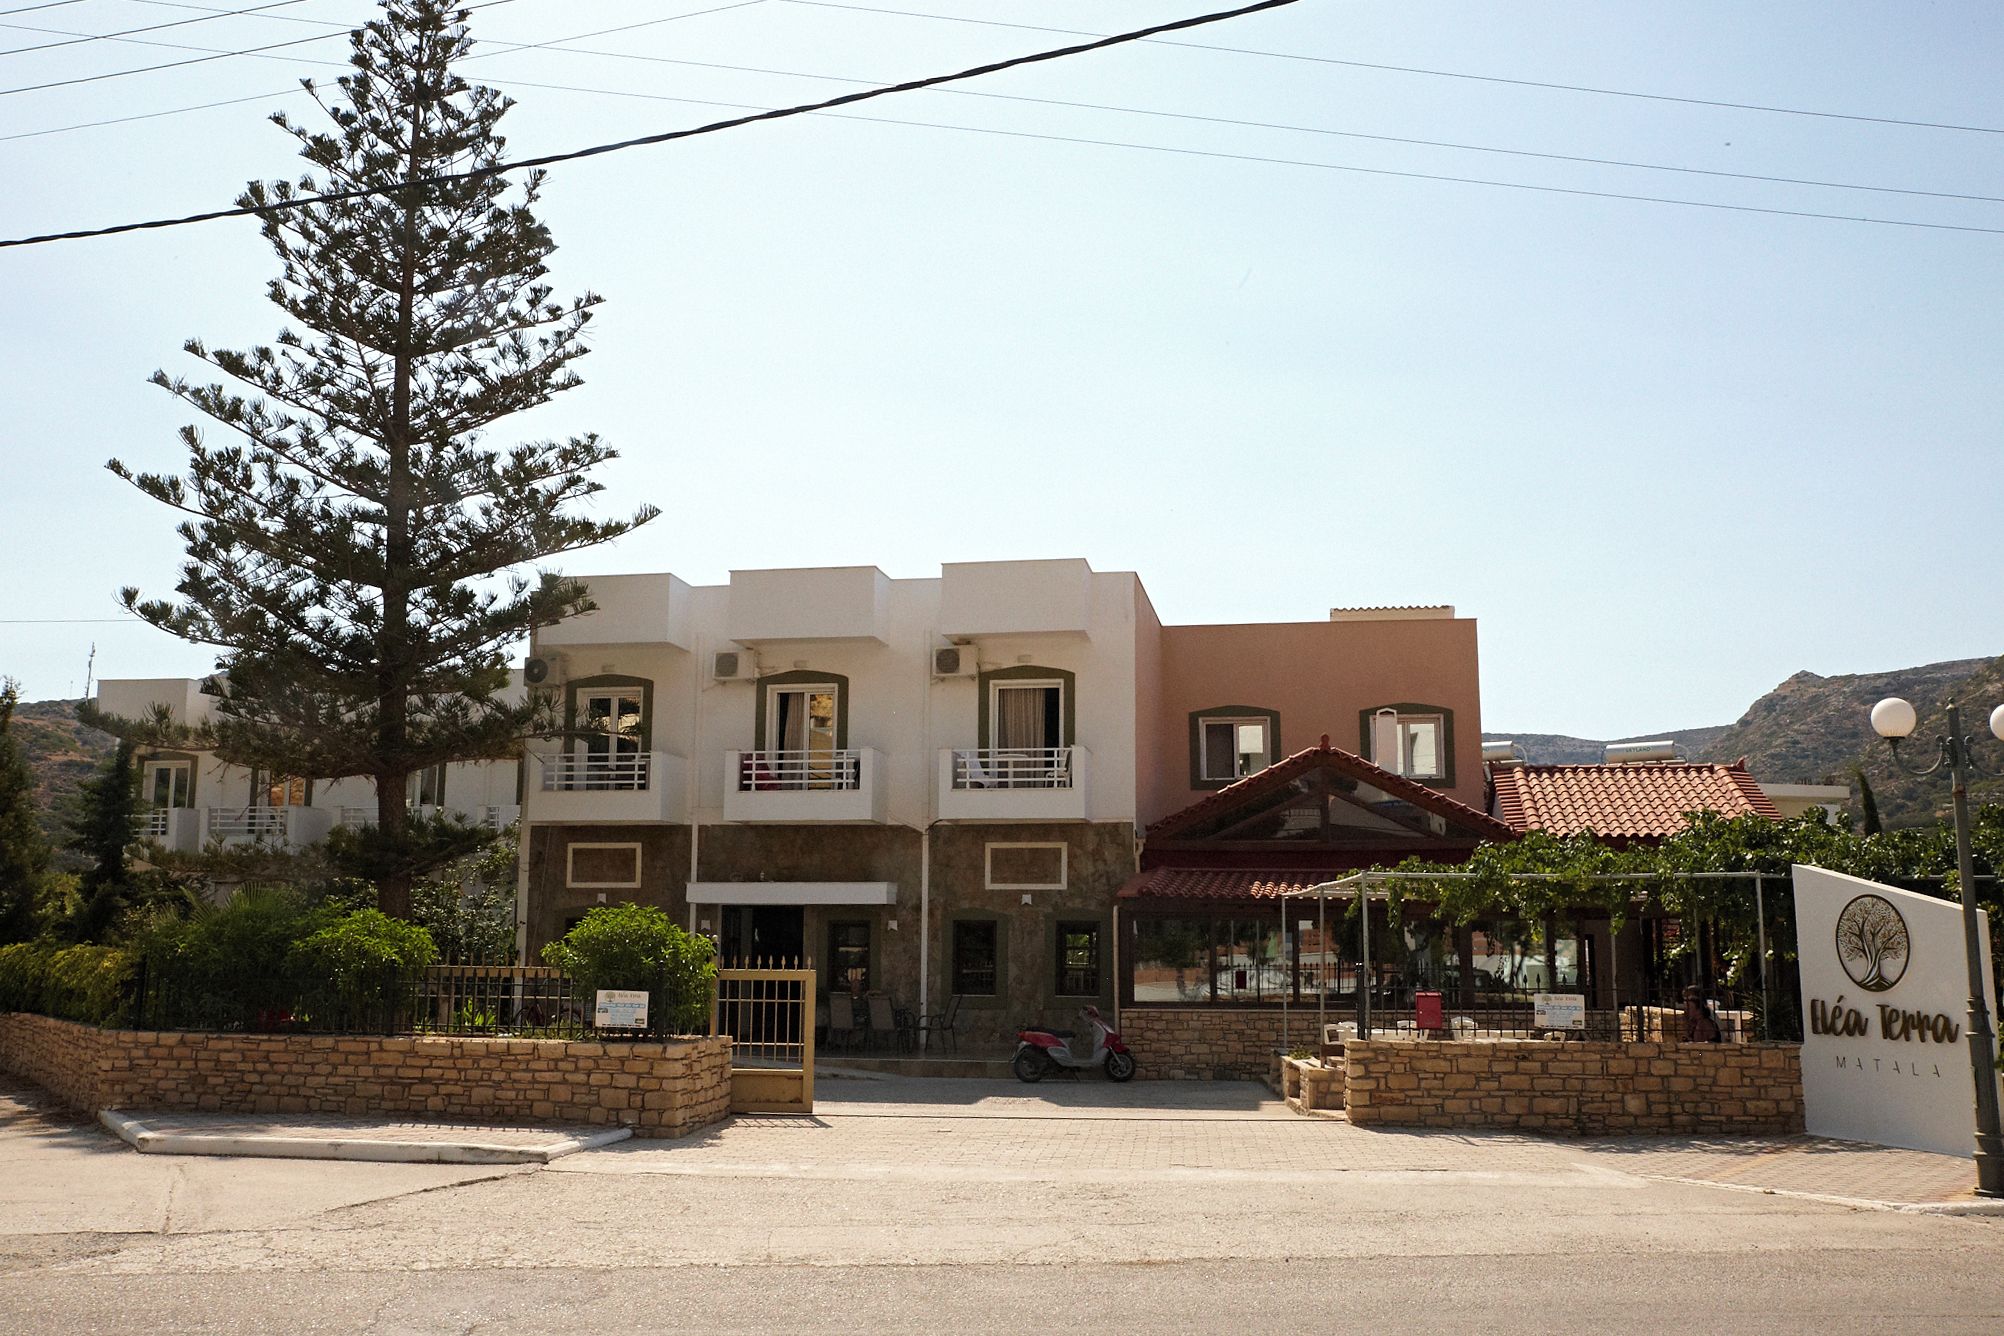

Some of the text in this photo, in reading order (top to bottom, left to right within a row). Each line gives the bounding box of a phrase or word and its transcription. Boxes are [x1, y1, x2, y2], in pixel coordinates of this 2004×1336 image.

[1810, 995, 1960, 1043] Eléa Terra
[1836, 1055, 1941, 1078] MATALA
